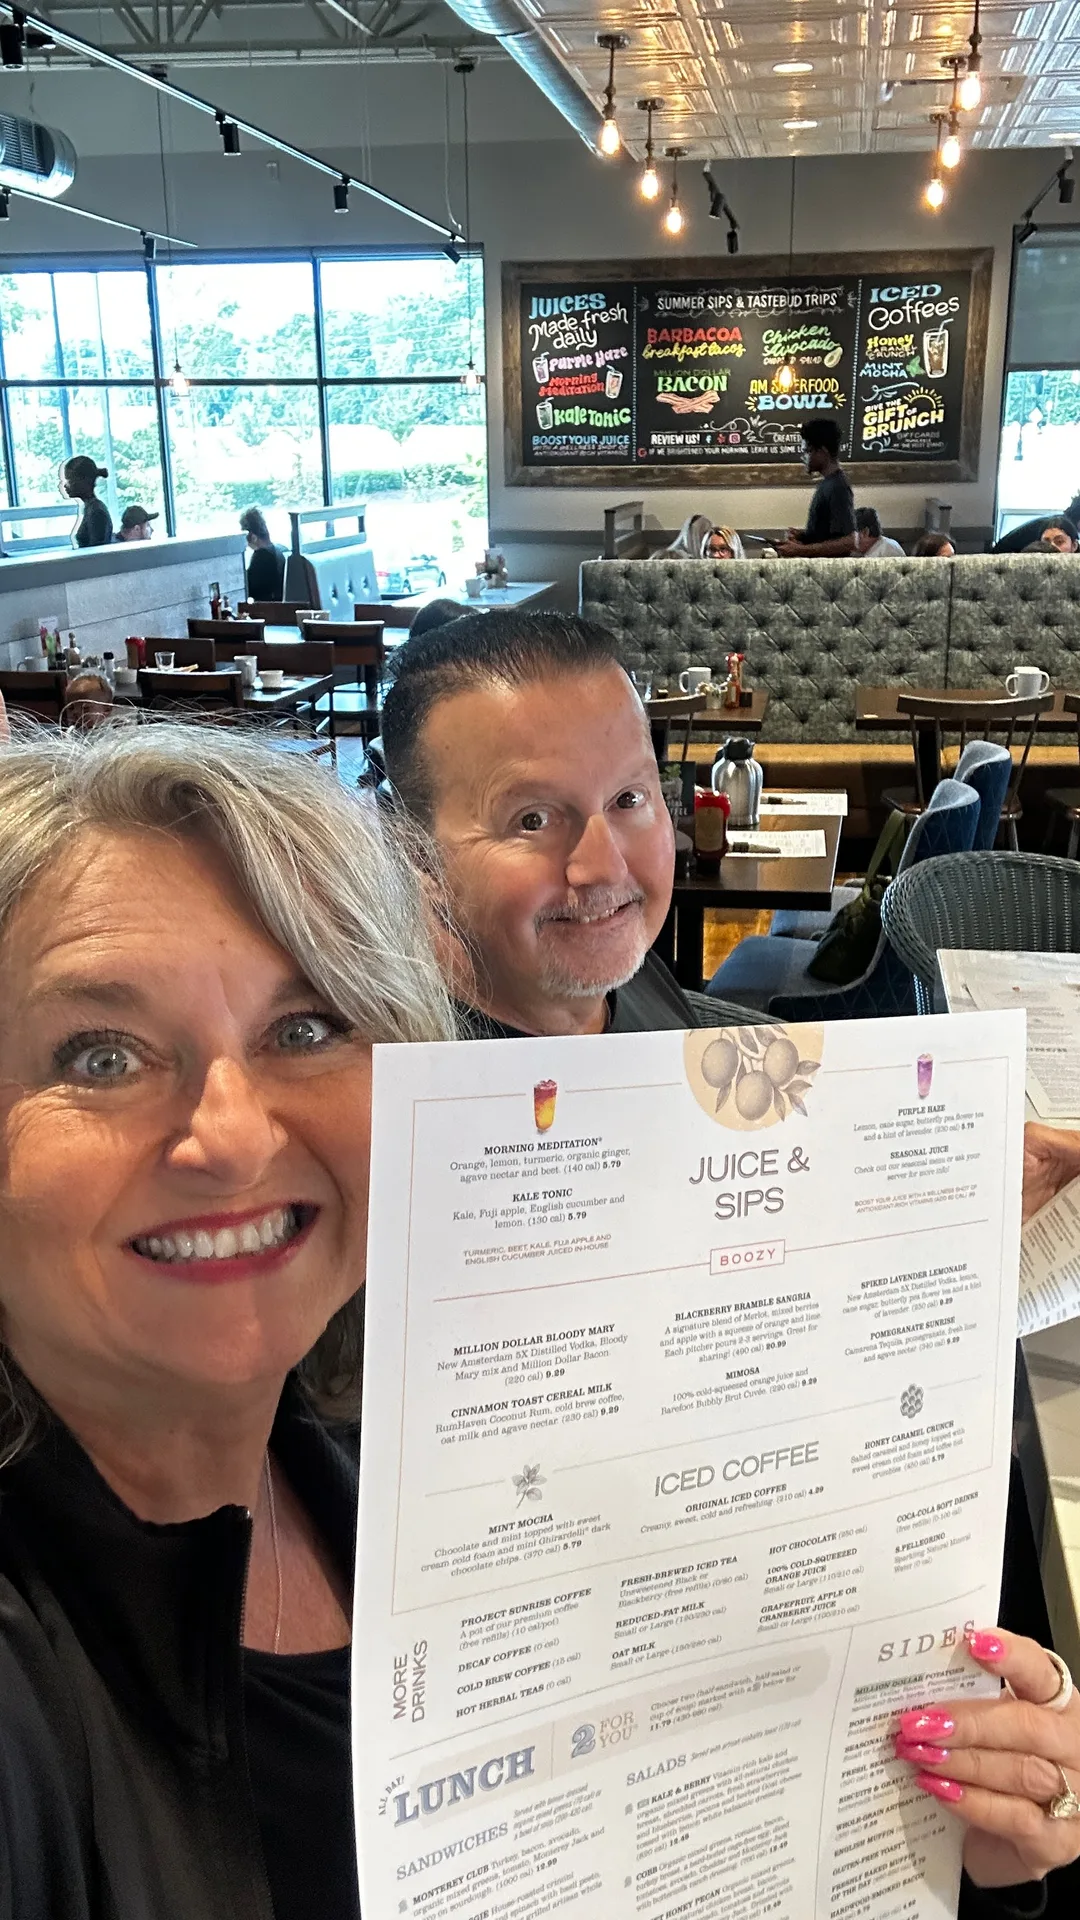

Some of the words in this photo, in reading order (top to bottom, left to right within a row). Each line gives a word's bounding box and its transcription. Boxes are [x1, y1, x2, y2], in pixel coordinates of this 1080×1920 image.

[657, 296, 704, 310] SUMMER
[707, 295, 733, 308] SIPS
[736, 296, 744, 308] &
[747, 293, 800, 308] TASTEBUD
[805, 293, 837, 306] TRIPS
[870, 284, 942, 303] ICED
[529, 293, 606, 319] JUICES
[868, 297, 960, 330] Coffees
[528, 314, 578, 351] Made
[581, 302, 629, 330] fresh
[647, 327, 742, 343] BARBACOA
[762, 324, 831, 344] Chicken
[553, 327, 597, 350] daily
[867, 334, 914, 349] Honey
[549, 354, 593, 372] Purple
[595, 346, 628, 368] Haze
[642, 342, 706, 362] breakfast
[708, 342, 746, 358] tacos
[868, 351, 915, 360] CRUNCH
[653, 368, 692, 376] MILLION
[693, 367, 731, 376] DOLLAR
[859, 369, 908, 378] MOCHA
[864, 362, 903, 370] MINT
[538, 382, 605, 397] Meditation
[549, 373, 598, 386] Morning
[657, 376, 728, 392] BACON
[750, 379, 767, 394] AM
[757, 394, 833, 410] BOWL
[865, 403, 884, 413] GIVE
[885, 398, 902, 407] THE
[862, 409, 944, 440] BRUNCH
[863, 404, 908, 425] GIFT
[532, 435, 567, 445] BOOST
[568, 435, 598, 445] YOUR
[599, 435, 630, 444] JUICE
[651, 434, 684, 445] REVIEW
[685, 433, 700, 444] US!
[751, 446, 768, 454] LEAVE
[898, 1106, 926, 1116] PURPLE
[928, 1104, 946, 1113] HAZE
[450, 1160, 487, 1171] Orange,
[490, 1158, 521, 1168] lemon,
[524, 1154, 564, 1165] turmeric,
[566, 1150, 600, 1161] organic
[602, 1148, 631, 1158] ginger,
[484, 1143, 534, 1155] MORNING
[890, 1148, 927, 1159] SEASONAL
[928, 1145, 949, 1155] JUICE
[460, 1173, 487, 1184] agave
[490, 1170, 519, 1180] nectar
[522, 1168, 538, 1177] and
[540, 1165, 560, 1175] beet.
[563, 1163, 583, 1174] (140
[585, 1162, 600, 1172] cal)
[602, 1160, 622, 1169] 5.79
[689, 1149, 779, 1184] JUICE
[787, 1146, 810, 1174] &
[512, 1192, 539, 1202] KALE
[542, 1188, 573, 1200] TONIC
[714, 1187, 784, 1220] SIPS
[720, 1248, 776, 1266] BOOZY
[861, 1278, 888, 1289] SPIKED
[890, 1271, 928, 1284] LAVENDER
[929, 1263, 968, 1277] LEMONADE
[675, 1304, 733, 1321] BLACKBERRY
[734, 1297, 775, 1312] BRAMBLE
[776, 1292, 812, 1305] SANGRIA
[453, 1342, 499, 1356] MILLION
[502, 1335, 543, 1350] DOLLAR
[546, 1329, 586, 1343] BLOODY
[588, 1323, 615, 1336] MARY
[870, 1324, 924, 1340] POMEGRANATE
[926, 1316, 955, 1329] SUNRISE
[726, 1367, 760, 1380] MIMOSA
[451, 1400, 509, 1419] CINNAMON
[511, 1395, 544, 1409] TOAST
[546, 1388, 585, 1402] CEREAL
[587, 1382, 612, 1395] MILK
[864, 1437, 890, 1450] HONEY
[892, 1429, 925, 1443] CARAMEL
[926, 1420, 955, 1433] CRUNCH
[654, 1465, 715, 1496] ICED
[722, 1440, 820, 1481] COFFEE
[685, 1497, 729, 1513] ORIGINAL
[730, 1492, 752, 1503] ICED
[754, 1483, 787, 1498] COFFEE
[896, 1506, 936, 1523] COCA-COLA
[936, 1499, 953, 1511] SOFT
[954, 1491, 979, 1504] DRINKS
[488, 1522, 516, 1535] MINT
[517, 1514, 554, 1528] MOCHA
[769, 1543, 787, 1555] HOT
[788, 1533, 838, 1550] CHOCOLATE
[621, 1564, 695, 1587] FRESH-BREWED
[696, 1559, 719, 1571] ICED
[720, 1555, 738, 1566] TEA
[461, 1610, 508, 1628] PROJECT
[509, 1598, 552, 1616] SUNRISE
[554, 1588, 592, 1604] COFFEE
[615, 1604, 680, 1629] REDUCED-FAT
[681, 1601, 706, 1612] MILK
[458, 1657, 491, 1673] DECAF
[493, 1646, 532, 1663] COFFEE
[612, 1648, 630, 1659] OAT
[631, 1641, 656, 1654] MILK
[392, 1653, 408, 1720] MORE
[411, 1638, 428, 1723] DRINKS
[457, 1679, 484, 1695] COLD
[485, 1672, 513, 1687] BREW
[514, 1661, 551, 1678] COFFEE
[456, 1705, 478, 1718] HOT
[479, 1693, 518, 1711] HERBAL
[520, 1685, 545, 1698] TEAS
[570, 1724, 596, 1759] 2
[600, 1710, 635, 1733] FOR
[626, 1754, 688, 1787] SALADS
[392, 1745, 536, 1827] LUNCH
[396, 1822, 510, 1881] SANDWICHES
[834, 1838, 866, 1857] ENGLISH
[412, 1876, 465, 1905] MONTEREY
[466, 1864, 490, 1881] CLUB
